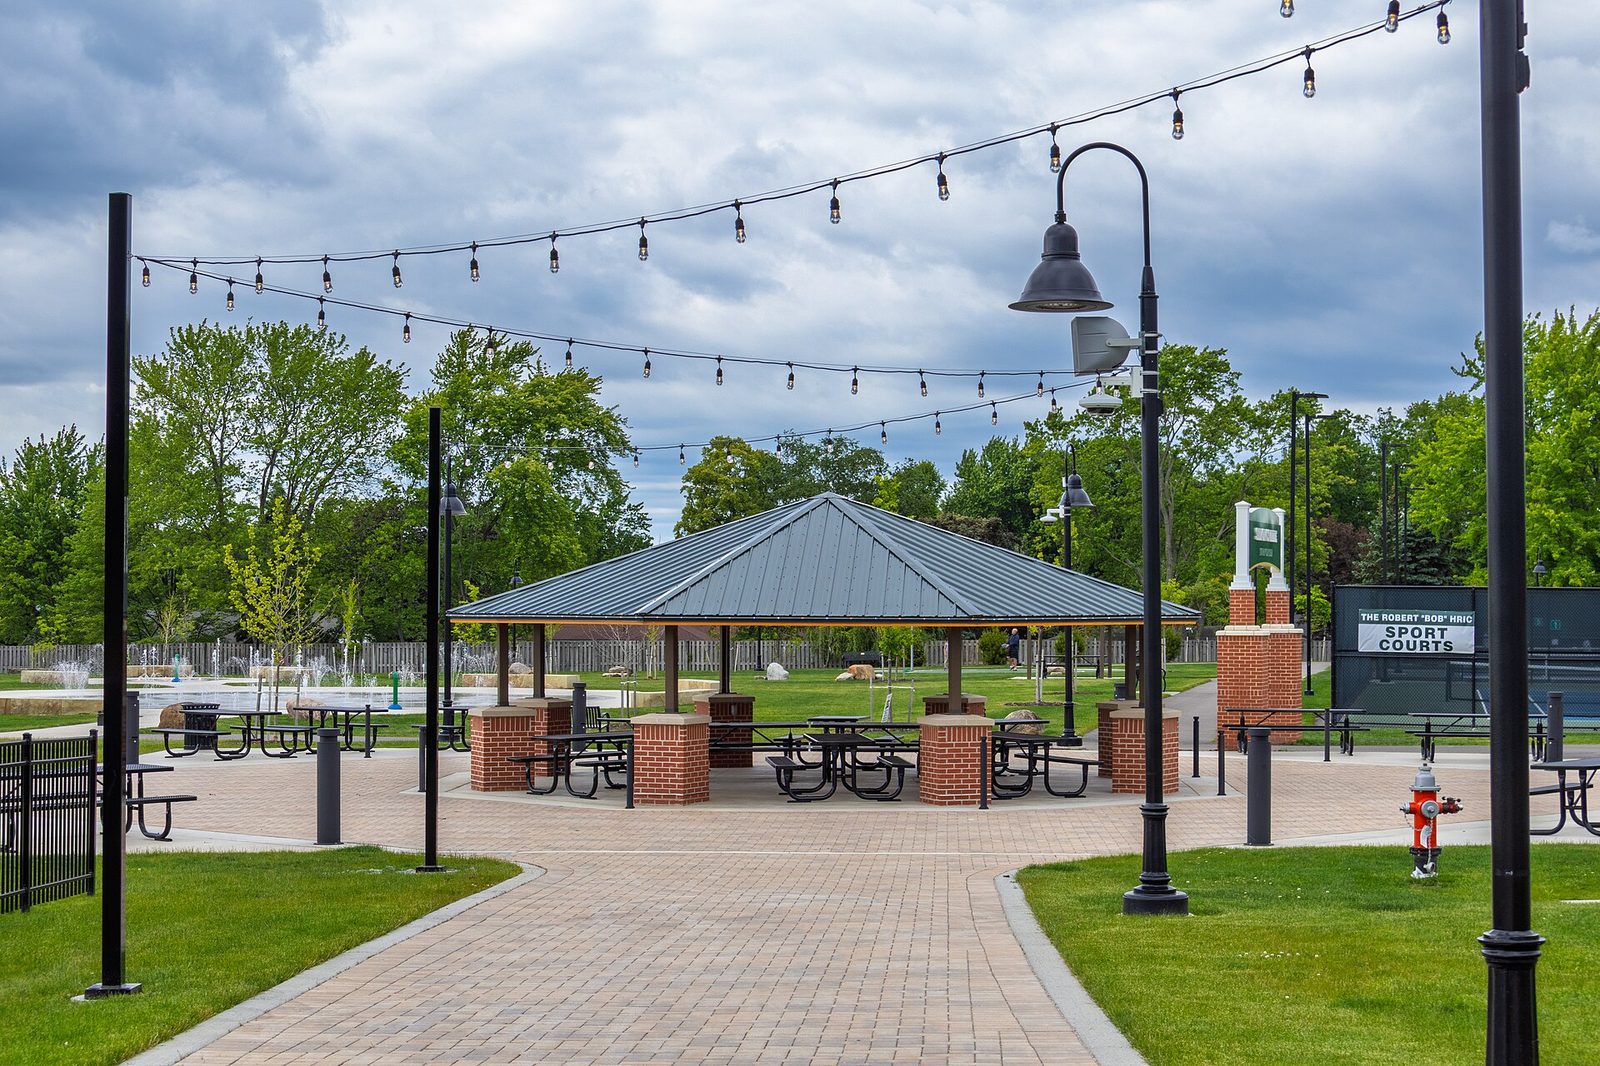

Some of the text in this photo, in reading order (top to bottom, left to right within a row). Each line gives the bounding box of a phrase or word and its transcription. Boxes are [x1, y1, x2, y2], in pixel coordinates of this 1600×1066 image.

[1361, 613, 1379, 621] THE
[1381, 613, 1419, 622] ROBERT
[1450, 615, 1473, 623] HRIC
[1385, 626, 1448, 639] SPORT
[1379, 639, 1454, 652] COURTS
